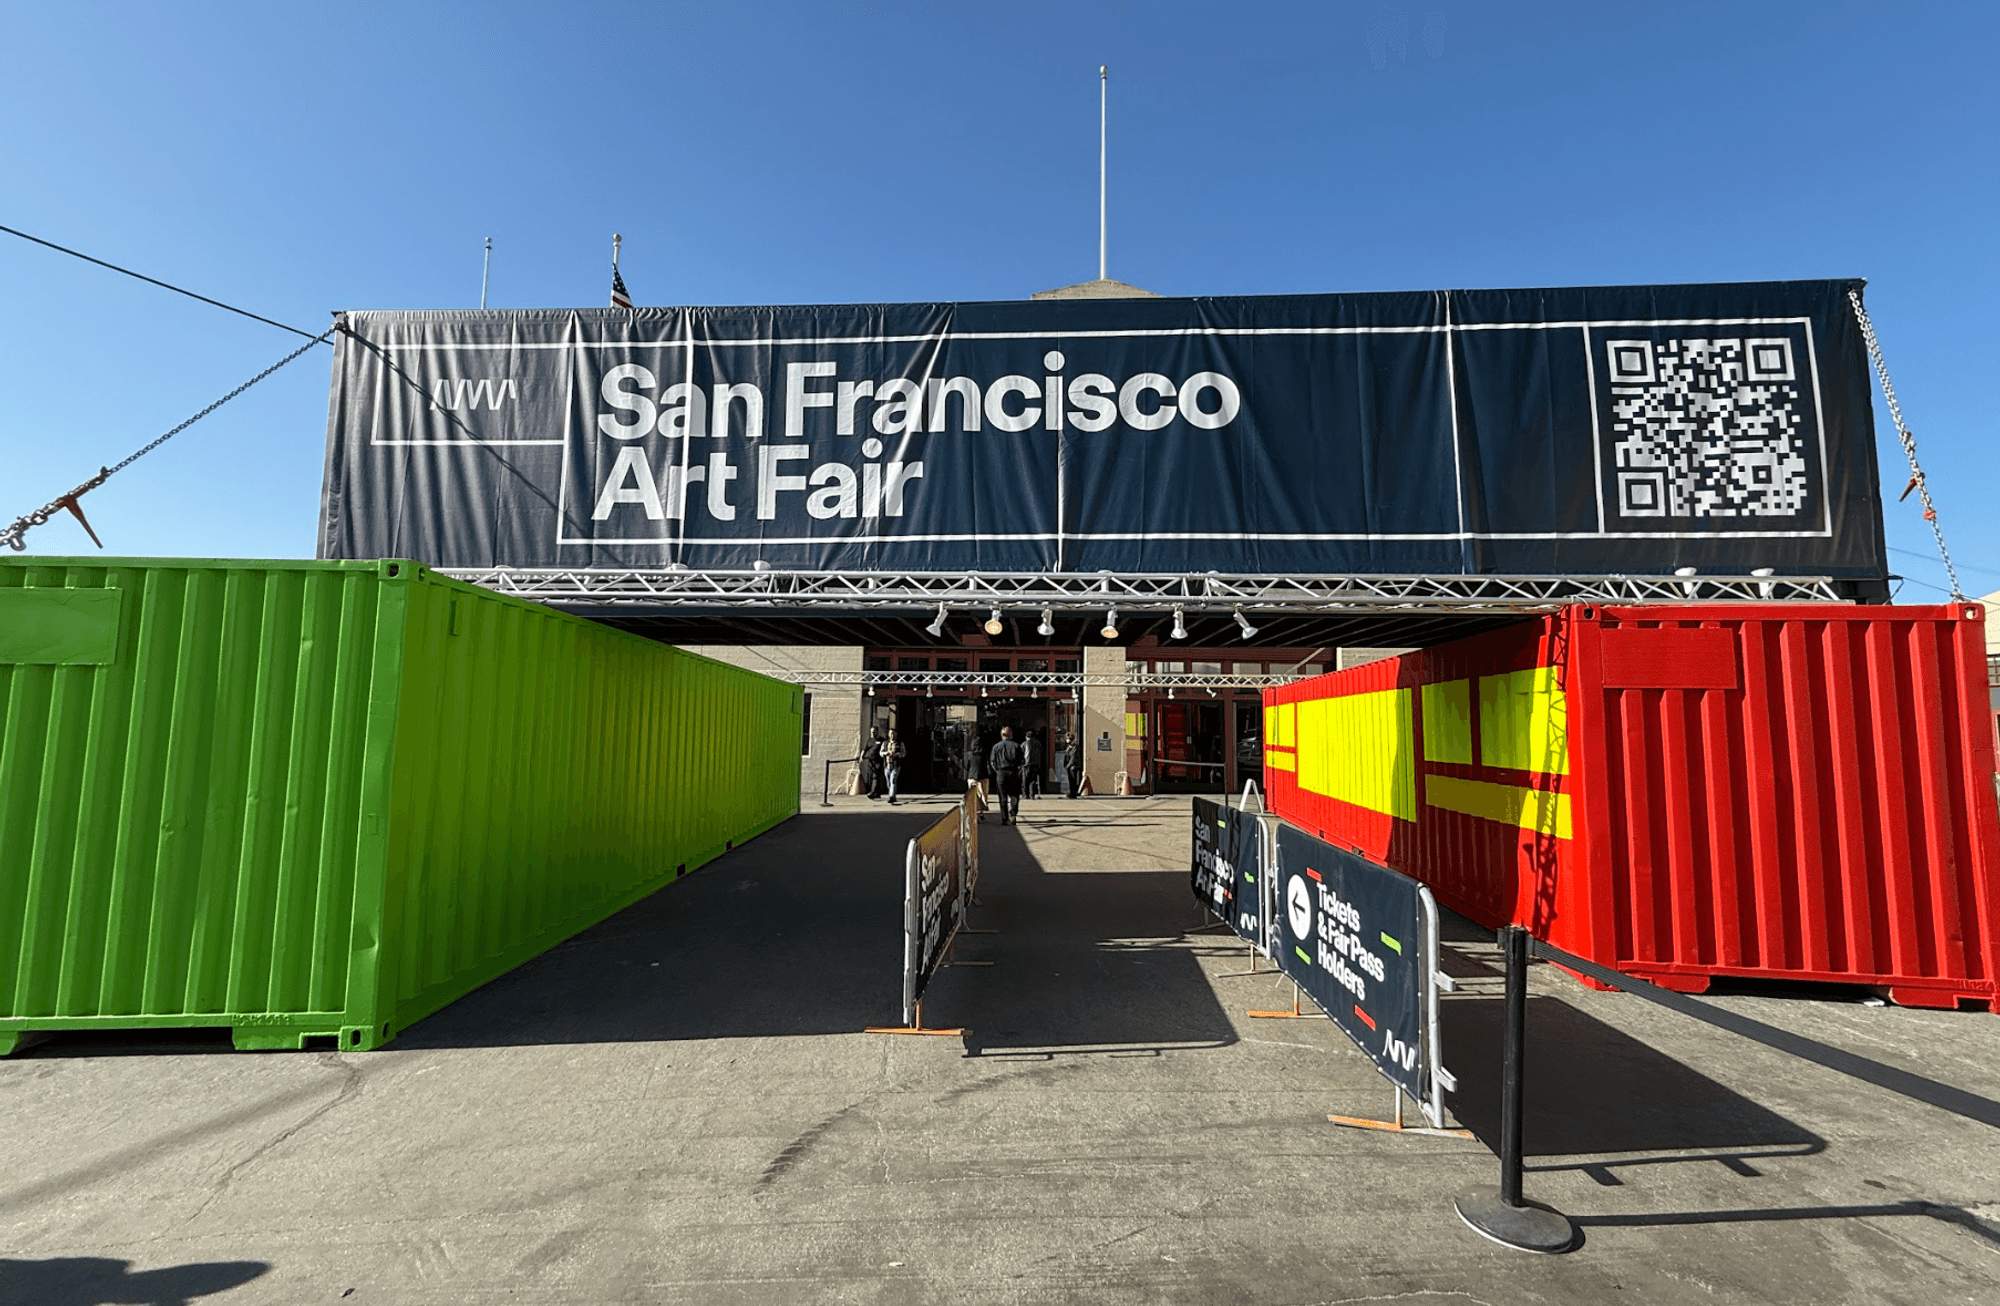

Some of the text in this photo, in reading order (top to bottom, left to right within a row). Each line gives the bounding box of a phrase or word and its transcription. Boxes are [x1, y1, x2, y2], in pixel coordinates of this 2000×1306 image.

[598, 352, 1242, 440] San Francisco
[592, 439, 925, 522] Art Fair
[1195, 815, 1211, 843] San
[1316, 882, 1361, 933] Tickets
[1317, 911, 1385, 983] & Fair Pass
[1317, 939, 1366, 1001] Holders
